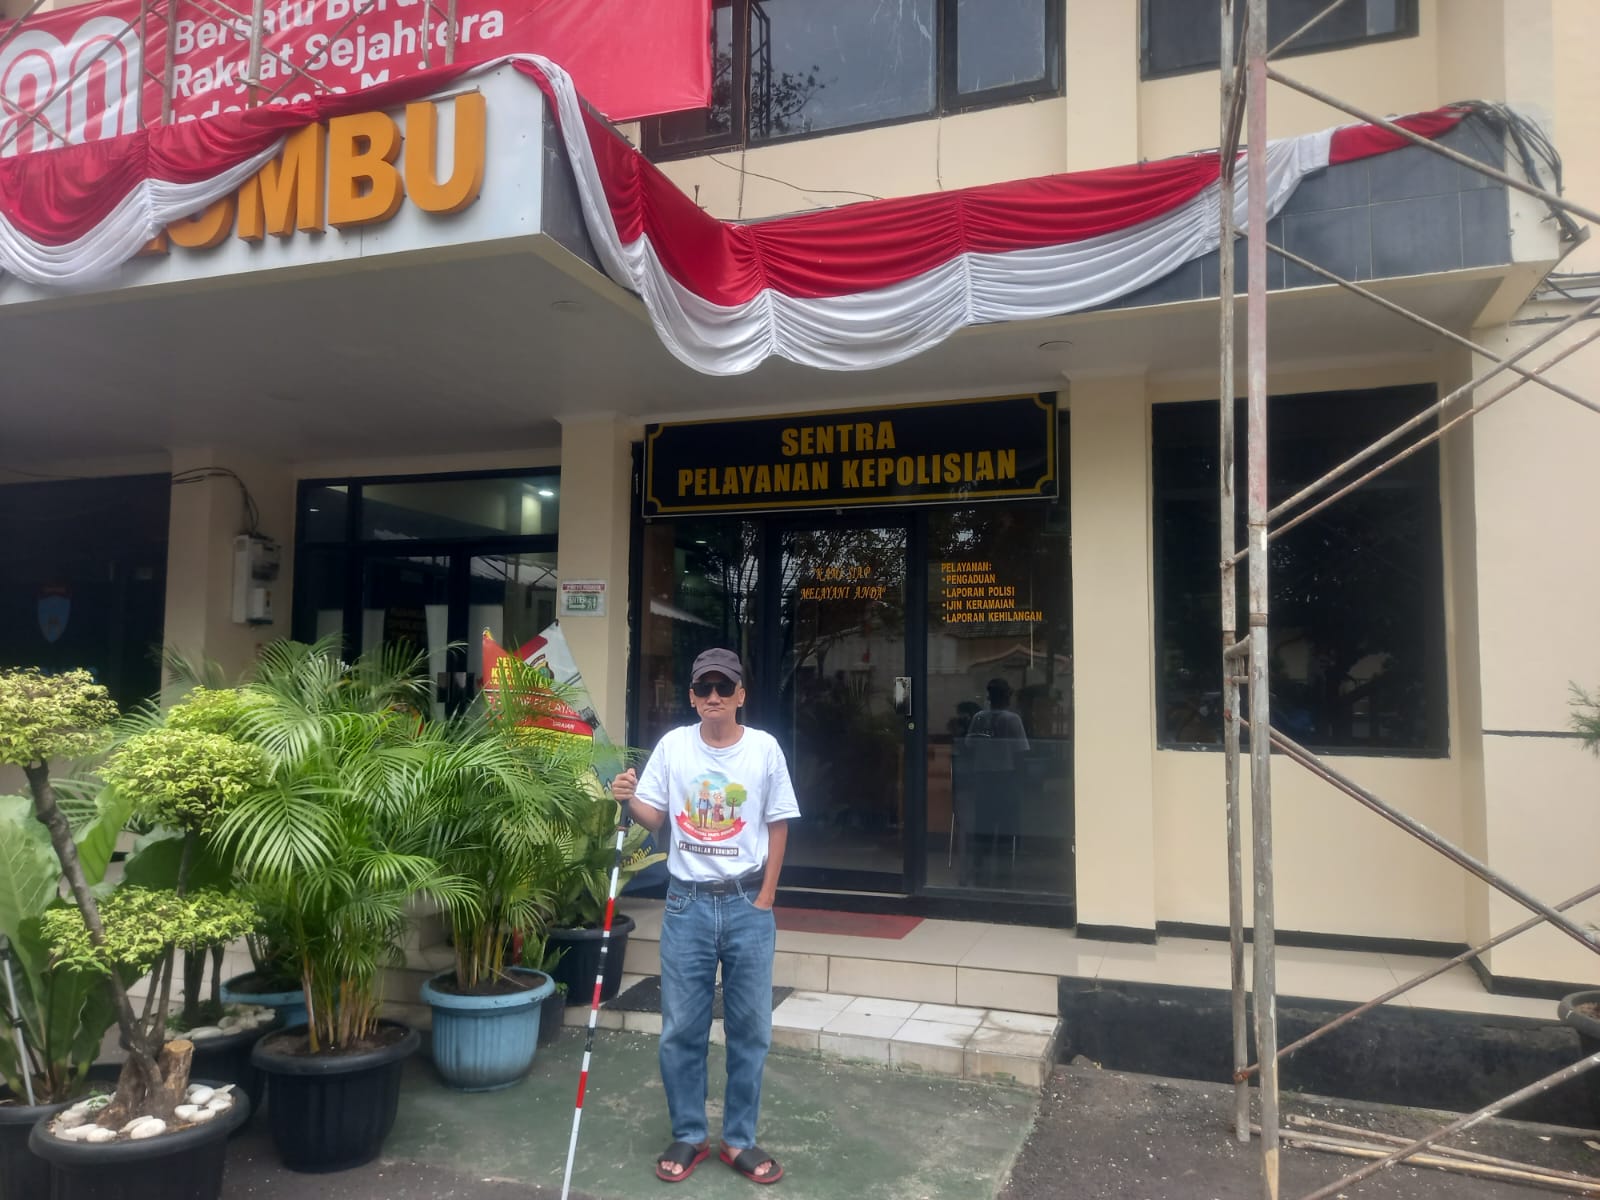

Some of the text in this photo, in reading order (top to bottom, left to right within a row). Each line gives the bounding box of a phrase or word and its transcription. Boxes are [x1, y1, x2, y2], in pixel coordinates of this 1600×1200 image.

[174, 0, 314, 54] Bersatu
[171, 43, 294, 99] Rakyat
[304, 9, 504, 74] Sejahtera
[781, 421, 896, 456] SENTRA
[678, 449, 1016, 497] PELAYANAN KEPOLISIAN
[941, 562, 992, 573] PELAYANAN:
[946, 574, 996, 585] PENGADUAN
[946, 586, 1015, 598] LAPORAN POLISI
[946, 599, 1015, 611] IJIN KERAMAIAN
[946, 611, 1043, 623] LAPORAN KEHILANGAN
